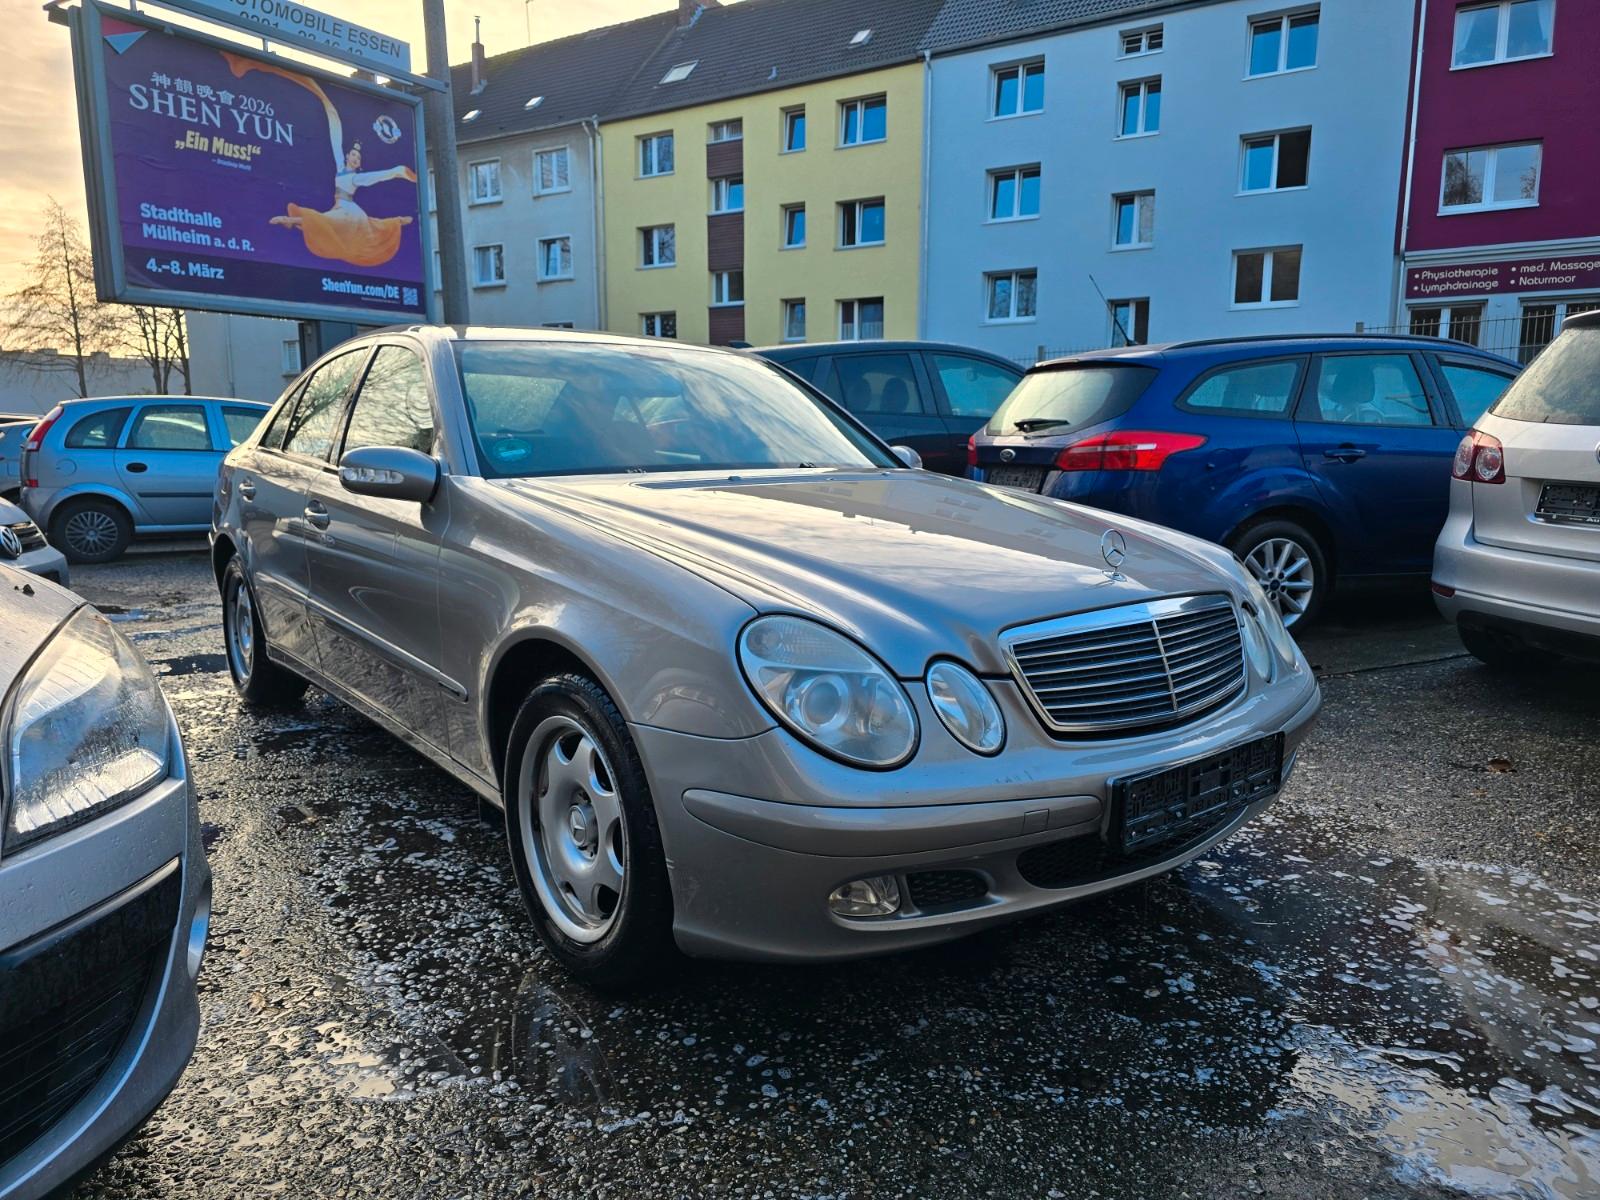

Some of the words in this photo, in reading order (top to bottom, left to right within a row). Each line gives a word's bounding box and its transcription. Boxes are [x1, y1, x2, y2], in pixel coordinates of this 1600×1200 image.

[348, 27, 401, 59] ESSEN
[150, 72, 235, 106] 神韻晚會
[129, 83, 222, 128] SHEN
[230, 108, 294, 147] YUN
[239, 94, 275, 117] 2026
[140, 202, 222, 229] Stadthalle
[142, 222, 212, 246] Mülheim
[213, 237, 226, 248] a.
[227, 236, 240, 250] d.
[241, 239, 255, 252] R.
[187, 262, 225, 280] März
[1421, 266, 1499, 281] Physiotherapie
[1520, 262, 1547, 273] med.
[321, 277, 400, 299] ShenYun.com/DE
[1420, 280, 1499, 294] Lymphdrainage
[1519, 275, 1577, 286] Naturmoor
